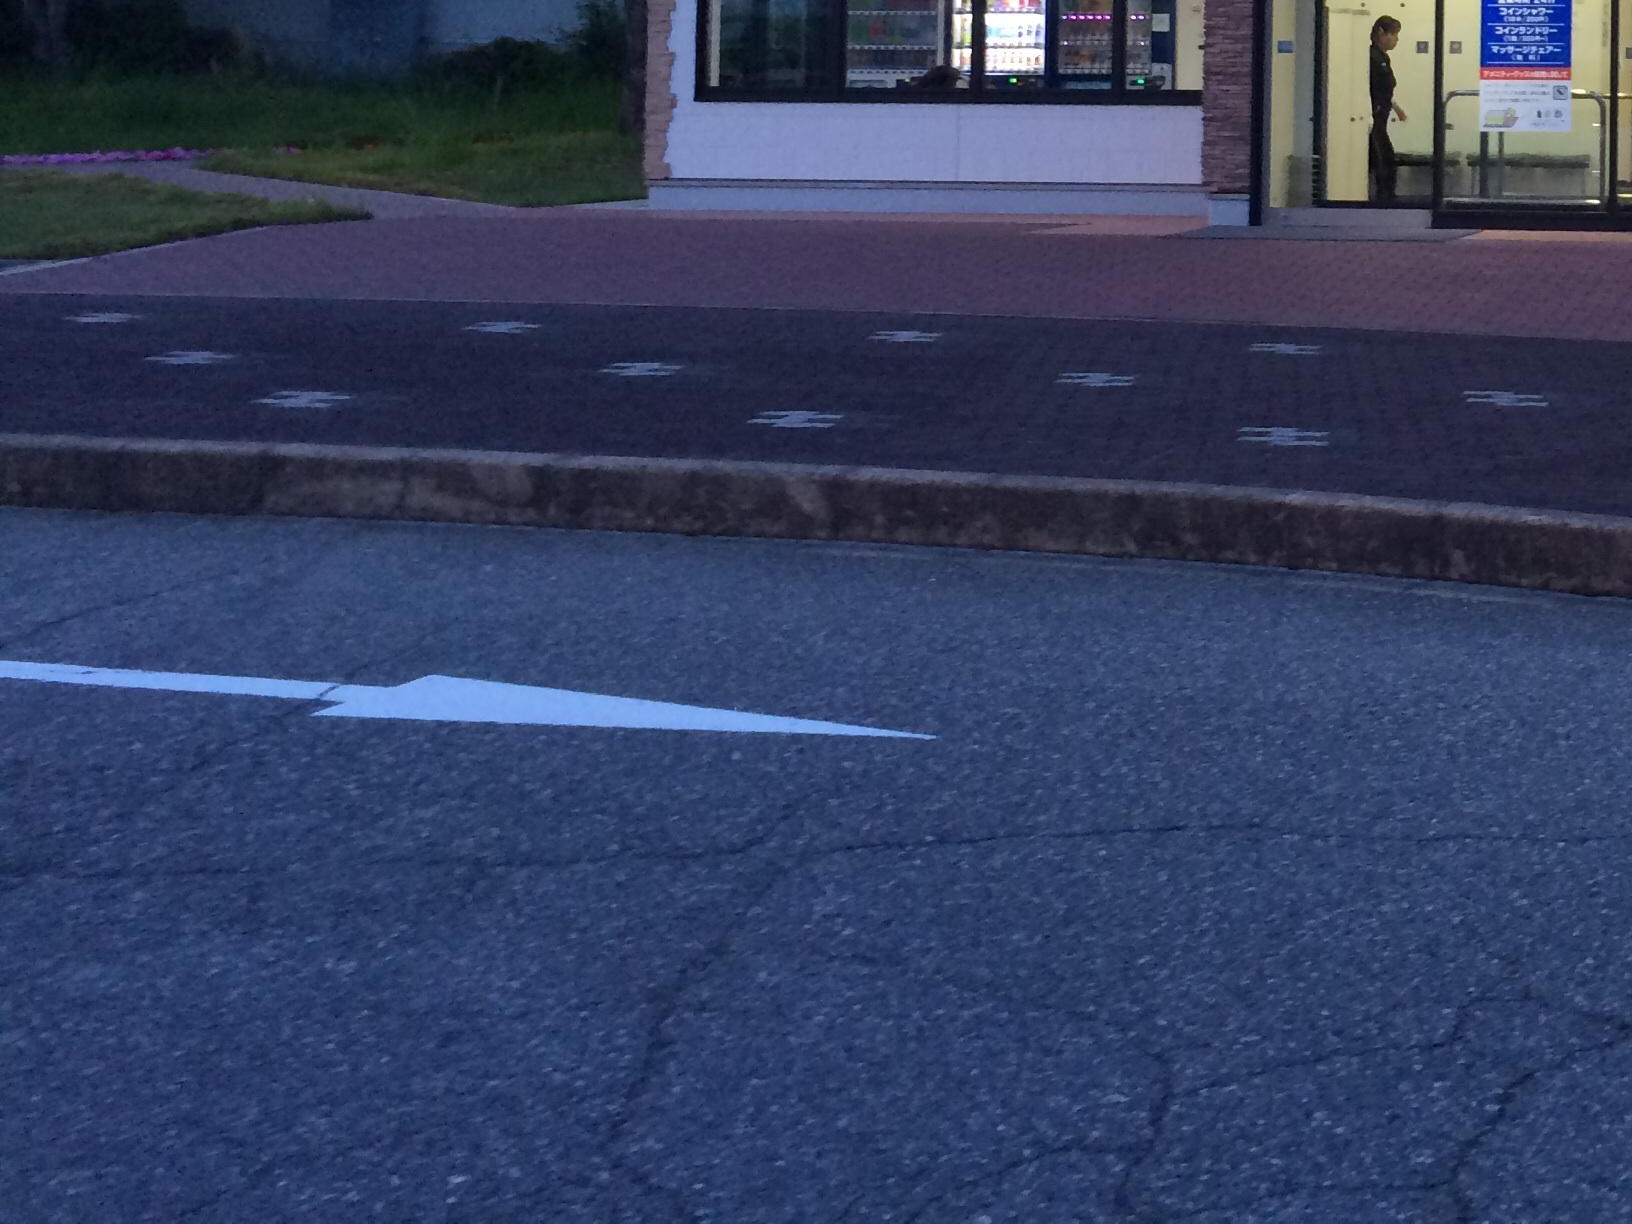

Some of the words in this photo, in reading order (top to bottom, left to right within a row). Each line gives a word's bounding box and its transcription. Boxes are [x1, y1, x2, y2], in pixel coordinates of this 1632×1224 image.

[1499, 7, 1554, 15] コインシャワー
[1494, 26, 1558, 35] コインランドリー
[1490, 46, 1562, 54] マッサージチェアー
